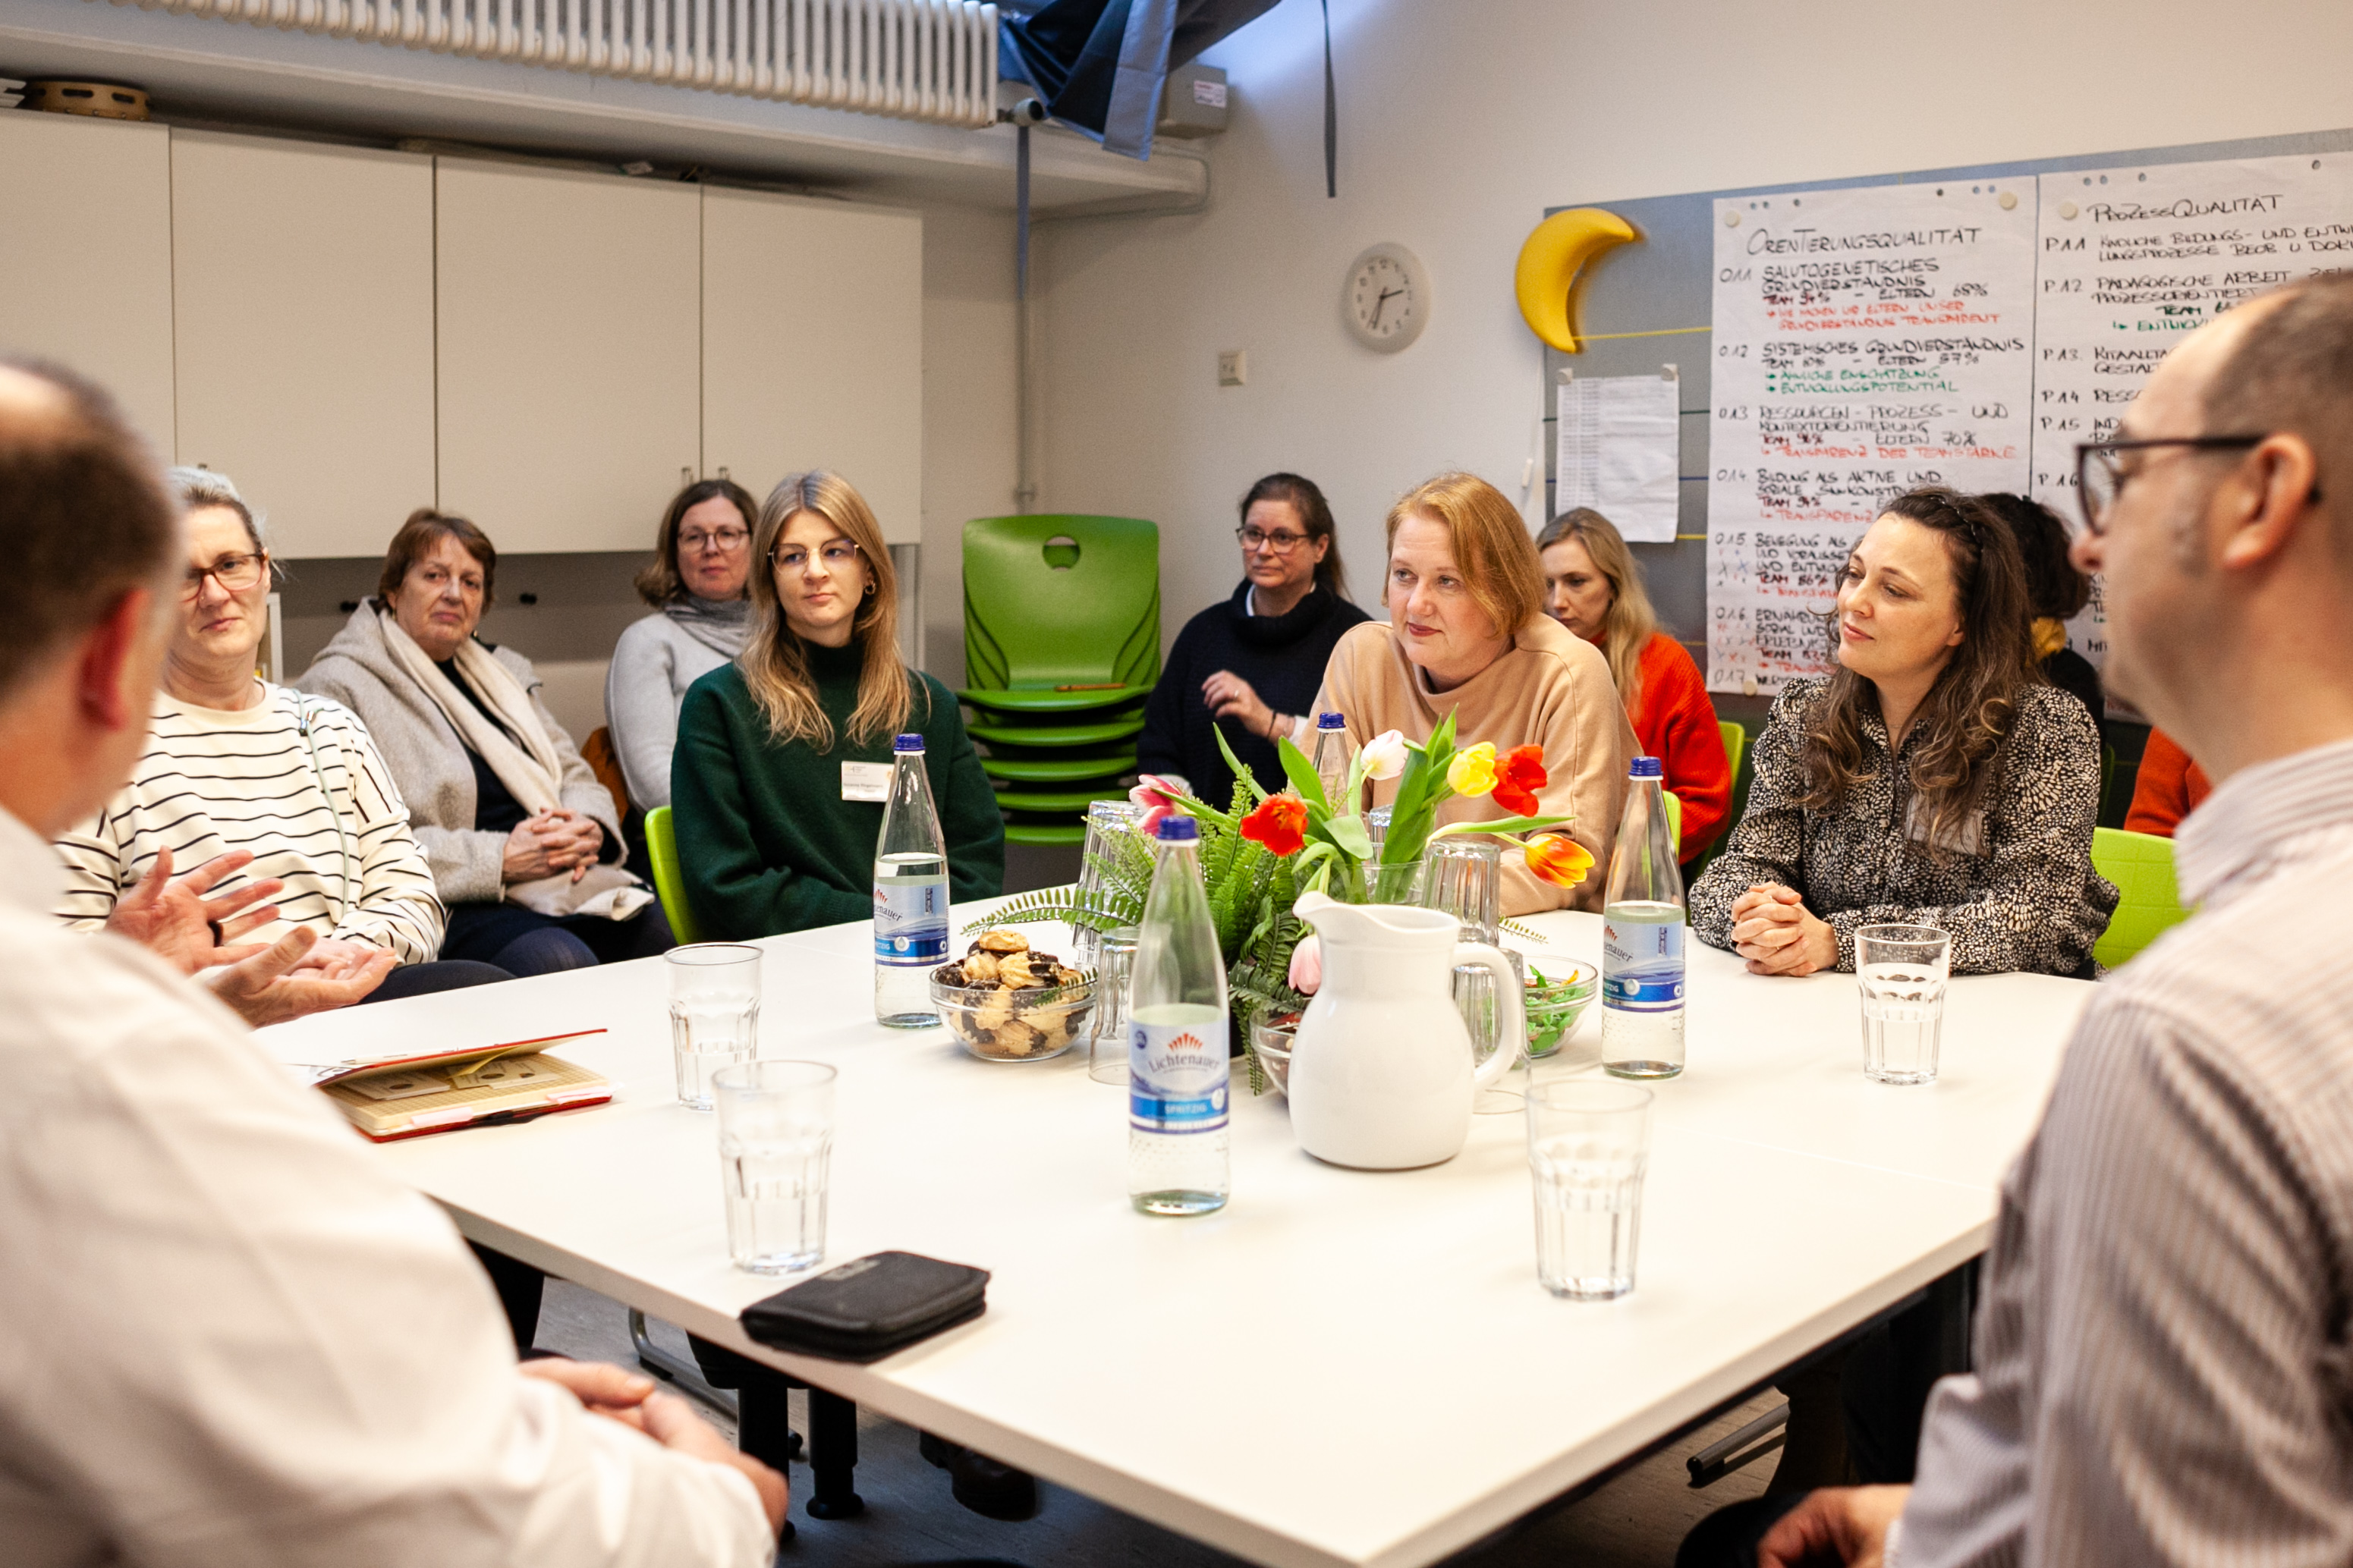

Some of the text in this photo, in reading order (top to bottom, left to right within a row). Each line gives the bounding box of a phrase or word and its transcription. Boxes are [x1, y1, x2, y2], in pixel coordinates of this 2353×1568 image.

[2262, 228, 2296, 240] UND
[2224, 269, 2291, 286] ARBEIT
[1972, 402, 2009, 419] UND
[1907, 470, 1942, 483] UND
[1147, 1052, 1221, 1074] Lichtenauer
